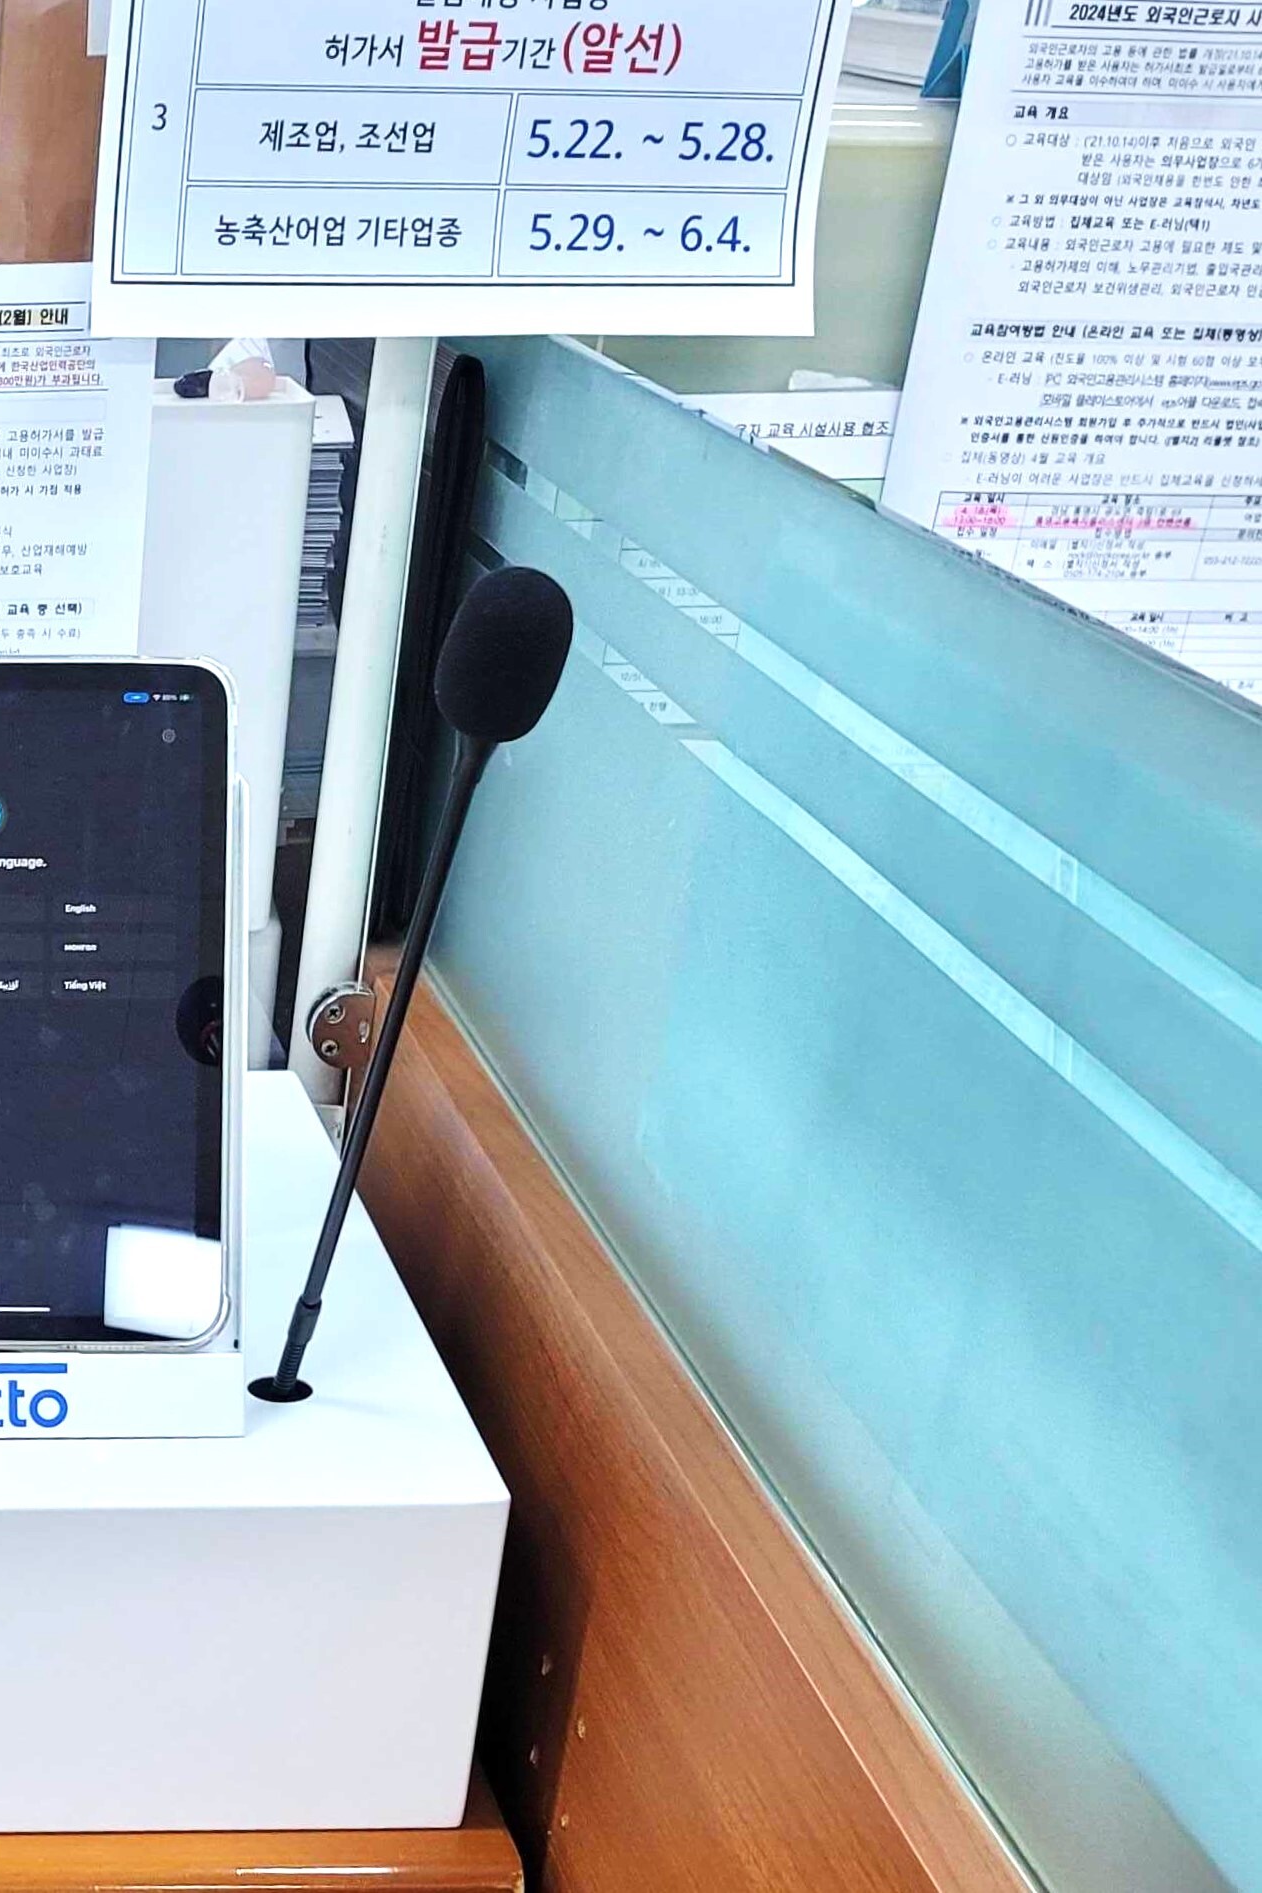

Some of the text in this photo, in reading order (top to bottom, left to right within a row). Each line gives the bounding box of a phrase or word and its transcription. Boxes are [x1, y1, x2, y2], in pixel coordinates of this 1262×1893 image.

[1069, 4, 1240, 26] 2024년도 외국인근로자
[325, 34, 404, 67] 허가서
[151, 103, 169, 131] 3
[1014, 105, 1069, 120] 교육 개요
[259, 120, 437, 154] 제조업, 조선업
[527, 119, 622, 159] 5.22.
[678, 122, 774, 162] 5.28.
[214, 214, 462, 248] 농축산어업 기타업종
[529, 213, 625, 252] 5.29.
[681, 215, 751, 252] 6.4.
[40, 308, 69, 325] 안내
[769, 423, 794, 438] 교육
[8, 604, 29, 616] 교육
[65, 904, 96, 914] English
